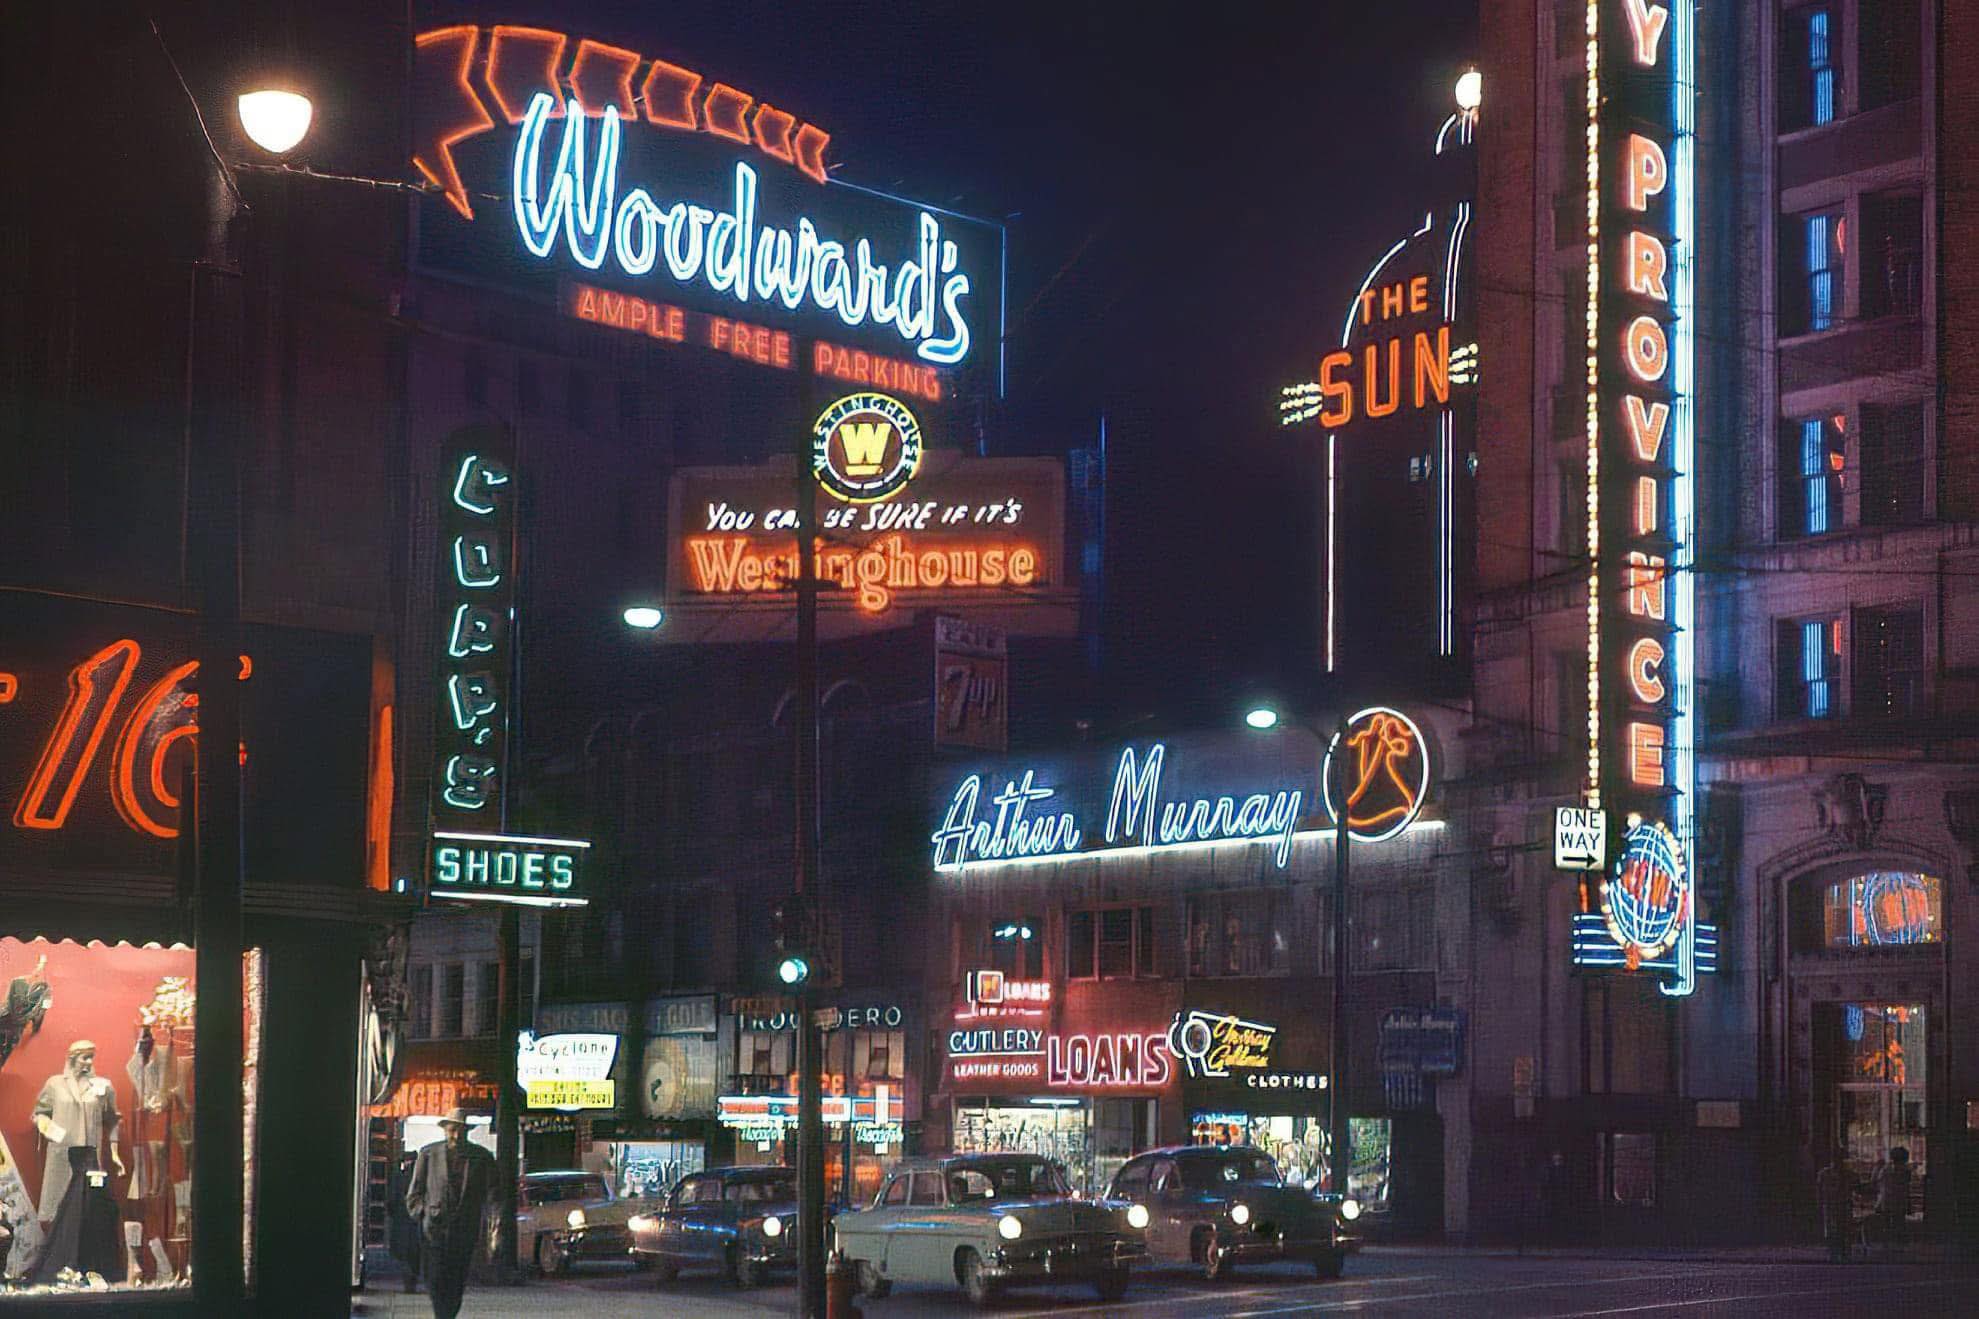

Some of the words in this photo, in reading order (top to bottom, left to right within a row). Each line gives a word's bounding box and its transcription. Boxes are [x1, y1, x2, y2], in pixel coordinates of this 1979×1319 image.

[513, 93, 970, 364] Woodward's
[1360, 277, 1428, 325] THE
[577, 286, 685, 342] AMPLE
[711, 316, 790, 367] FREE
[813, 341, 941, 400] PARKING
[1319, 327, 1450, 428] SUN
[813, 397, 919, 473] WESTINGHOUSE
[1626, 132, 1669, 787] PROVINCE
[764, 509, 800, 530] CA
[861, 502, 937, 531] SURE
[941, 507, 968, 525] IF
[975, 498, 1022, 524] IT'S
[690, 536, 1036, 611] Westinghouse
[932, 770, 1081, 867] Arthur
[1105, 743, 1302, 868] Murray
[1560, 810, 1600, 829] ONE
[1560, 831, 1600, 849] WAY
[439, 848, 573, 888] SHOES
[1004, 982, 1050, 1000] LOANS
[740, 1006, 902, 1030] TRODERO
[950, 1030, 1043, 1052] CUTLERY
[1047, 1034, 1170, 1086] LOANS
[954, 1065, 1000, 1077] LEATHER
[1002, 1063, 1039, 1076] GOODS
[1247, 1075, 1329, 1088] CLOTHES
[370, 1079, 457, 1117] NGER
